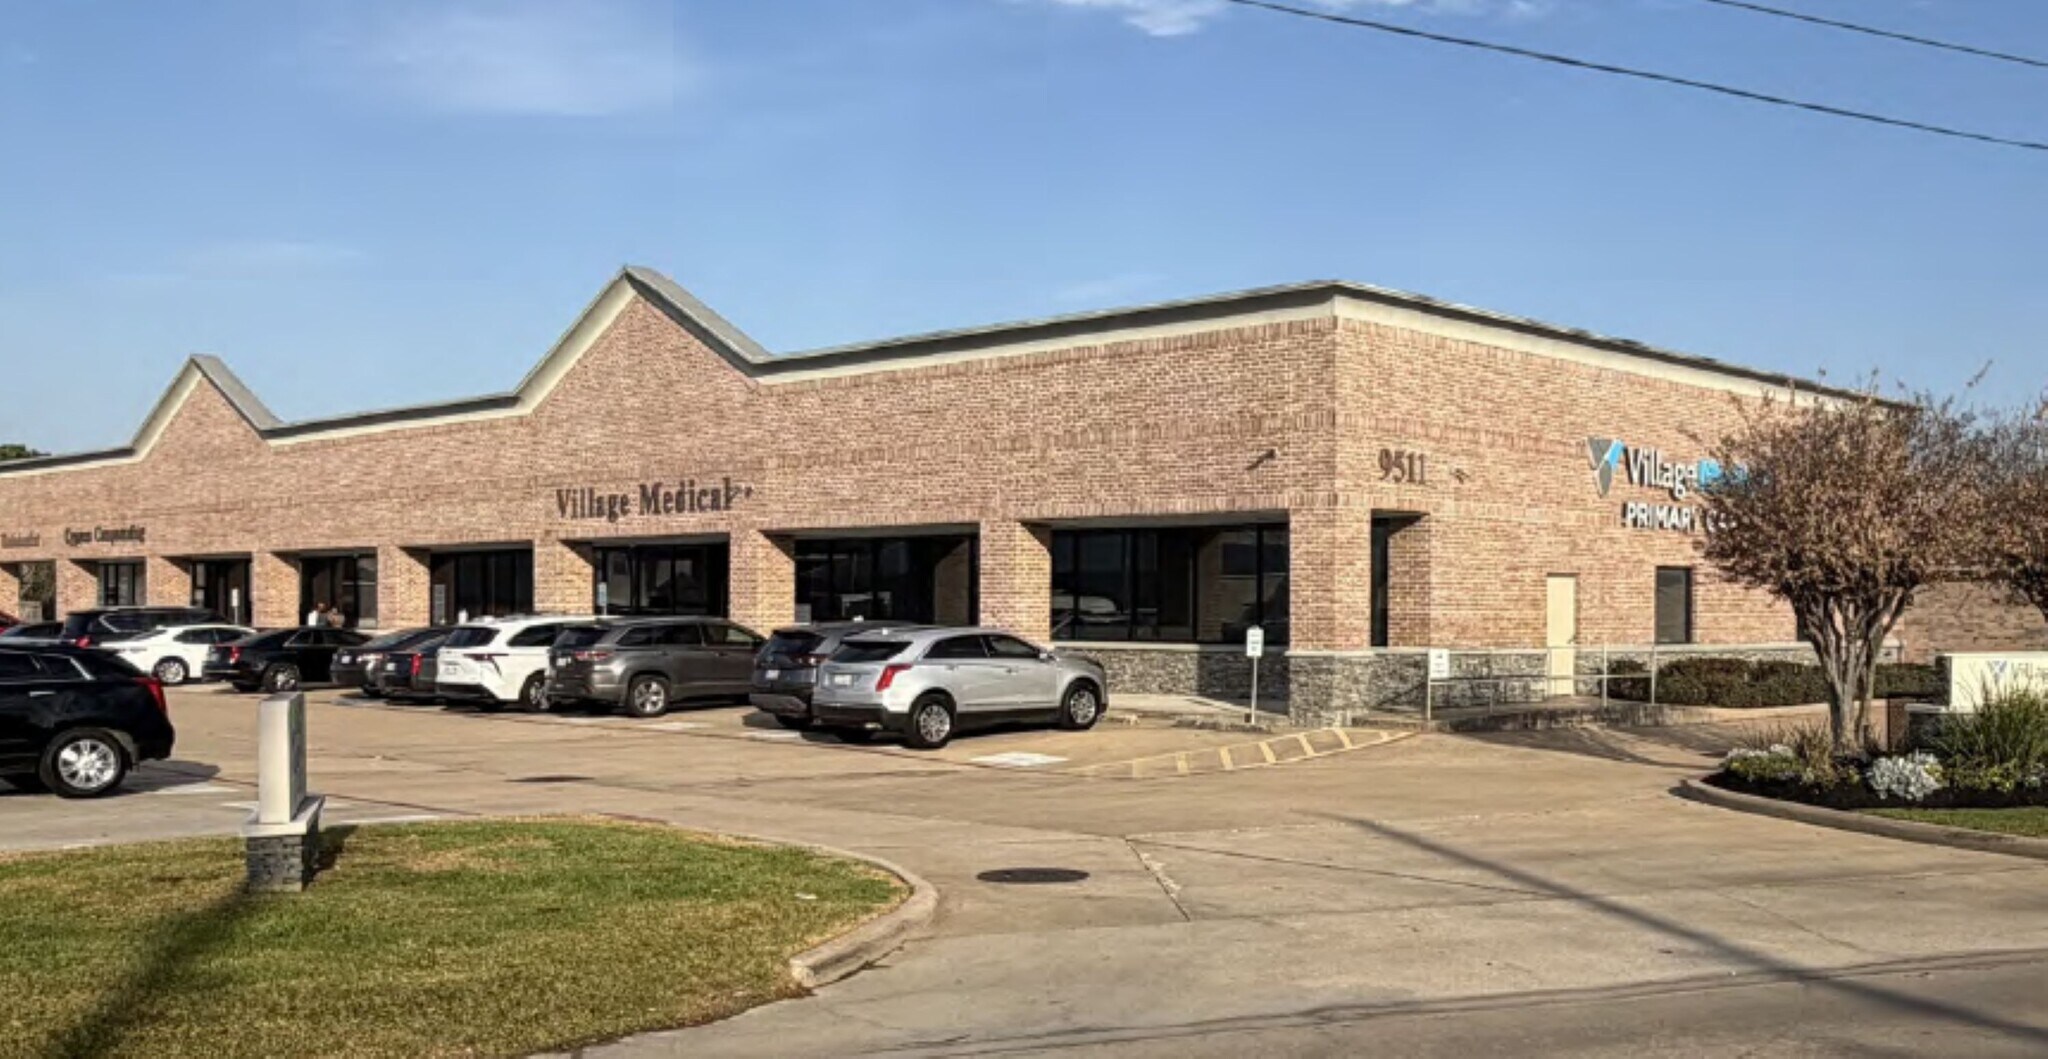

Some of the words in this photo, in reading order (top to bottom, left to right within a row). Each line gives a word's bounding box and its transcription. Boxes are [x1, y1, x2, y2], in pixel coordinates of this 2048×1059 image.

[1378, 449, 1426, 485] 9511
[555, 487, 630, 523] Village
[639, 477, 732, 516] Medical
